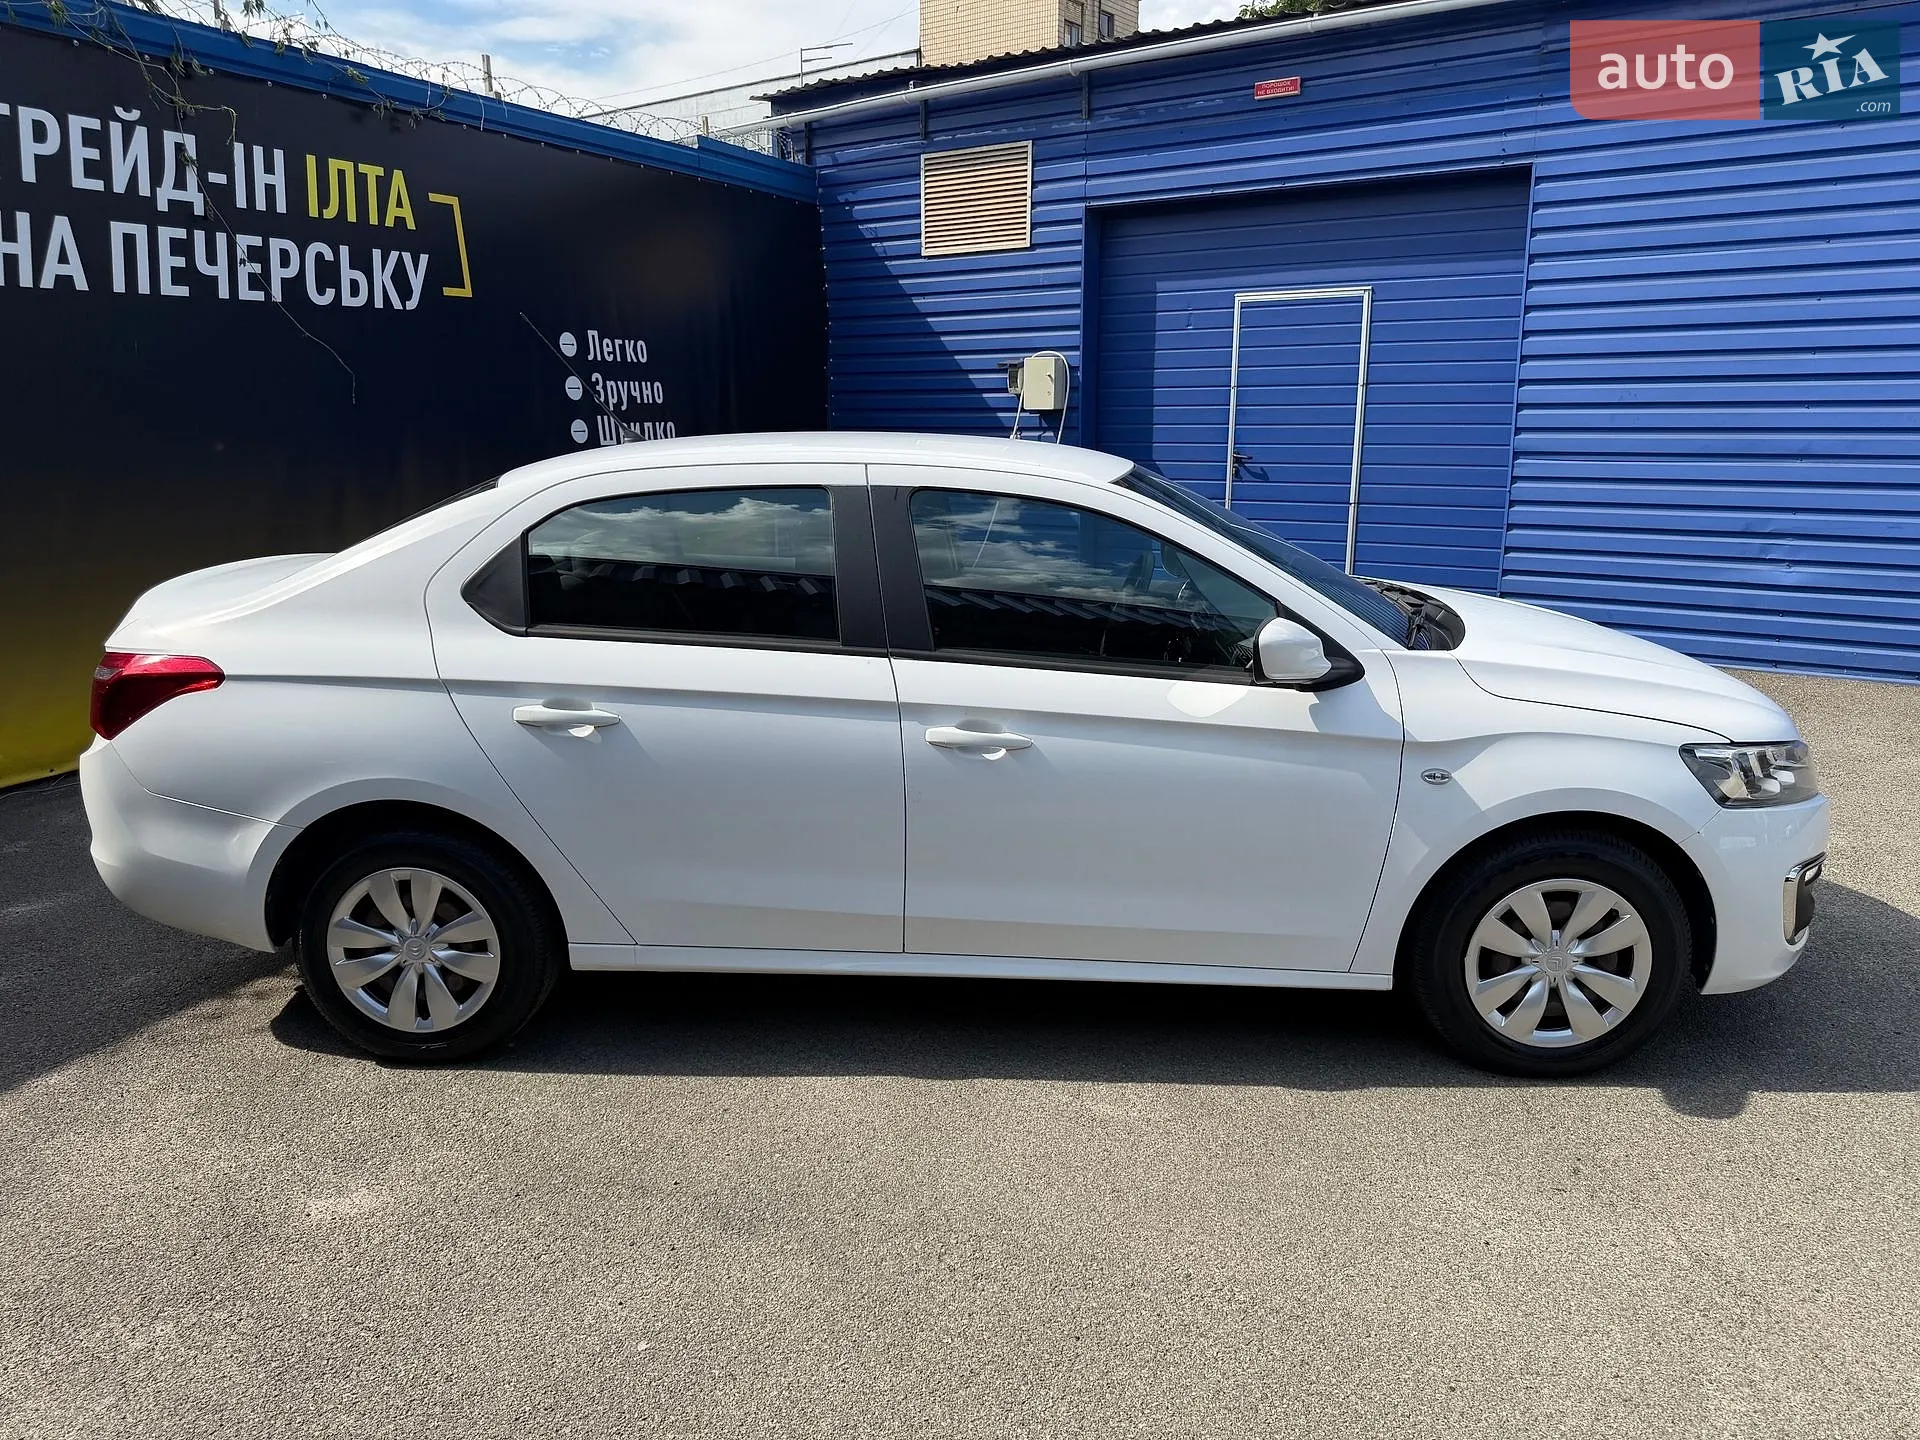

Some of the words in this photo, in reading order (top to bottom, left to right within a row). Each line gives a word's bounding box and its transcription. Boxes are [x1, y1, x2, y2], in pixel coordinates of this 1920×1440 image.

[0, 103, 287, 216] РЕЙД-ІН
[306, 154, 416, 230] ІЛТА
[0, 210, 89, 292] НА
[110, 220, 429, 310] ПЕЧЕРСЬКУ
[587, 330, 648, 363] Легко
[591, 372, 663, 411] Зручно
